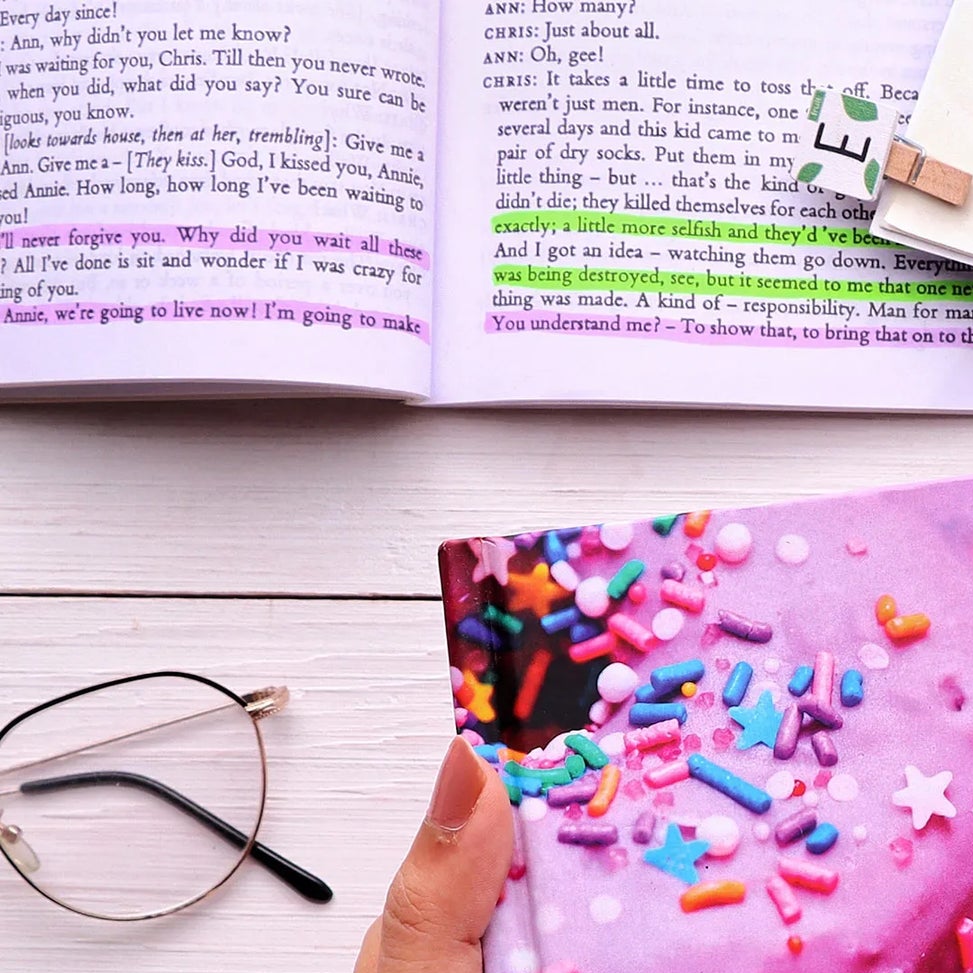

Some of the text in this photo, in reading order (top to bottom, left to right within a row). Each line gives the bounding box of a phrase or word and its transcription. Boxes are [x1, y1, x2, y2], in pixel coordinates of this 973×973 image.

[0, 1, 117, 30] Every day since!
[484, 0, 636, 19] ANN: How many?
[10, 22, 291, 51] Ann, why didn't you let me know?
[484, 20, 660, 43] CHRIS: Just about all.
[483, 44, 604, 68] ANN: Oh, gee!
[7, 73, 426, 113] when you did, what did you say? You sure can be
[46, 127, 98, 148] towards
[102, 126, 145, 146] house,
[152, 124, 184, 142] then
[190, 128, 205, 142] at
[212, 124, 241, 145] her,
[345, 132, 385, 154] Give
[390, 144, 413, 160] me
[417, 150, 425, 162] a
[496, 144, 528, 167] pair
[534, 142, 556, 160] of
[559, 142, 589, 166] dry
[596, 143, 646, 162] socks.
[654, 145, 685, 163] Put
[692, 146, 736, 166] them
[744, 150, 761, 167] in
[813, 121, 872, 163] E
[24, 174, 424, 213] Annie. How long, how long I've been waiting to
[22, 224, 422, 261] never forgive you. Why did you wait all these
[494, 215, 557, 238] exactly;
[562, 222, 572, 233] a
[577, 215, 615, 234] little
[621, 223, 666, 236] more
[671, 218, 722, 238] selfish
[728, 222, 758, 240] and
[764, 222, 818, 248] they'd
[822, 224, 848, 244] 've
[493, 270, 522, 282] was
[527, 263, 573, 288] being
[578, 264, 664, 288] destroyed,
[670, 274, 700, 288] see,
[706, 268, 735, 287] but
[739, 271, 752, 288] it
[756, 273, 819, 291] seemed
[824, 278, 842, 292] to
[846, 281, 873, 294] me
[878, 276, 912, 295] that
[916, 283, 948, 296] one
[4, 299, 422, 333] Annie, we're going to live now! I'm going to make
[492, 289, 534, 312] thing
[540, 294, 571, 306] was
[578, 289, 628, 308] made.
[635, 292, 651, 308] A
[657, 291, 696, 310] kind
[702, 293, 724, 311] of
[743, 297, 860, 322] responsibility.
[867, 301, 907, 319] Man
[912, 300, 939, 320] for
[492, 315, 526, 331] You
[530, 313, 621, 332] understand
[626, 316, 661, 333] me?
[680, 317, 706, 334] To
[710, 318, 755, 336] show
[760, 320, 797, 341] that,
[802, 326, 820, 340] to
[825, 322, 870, 347] bring
[875, 324, 908, 343] that
[911, 331, 934, 344] on
[938, 330, 956, 344] to
